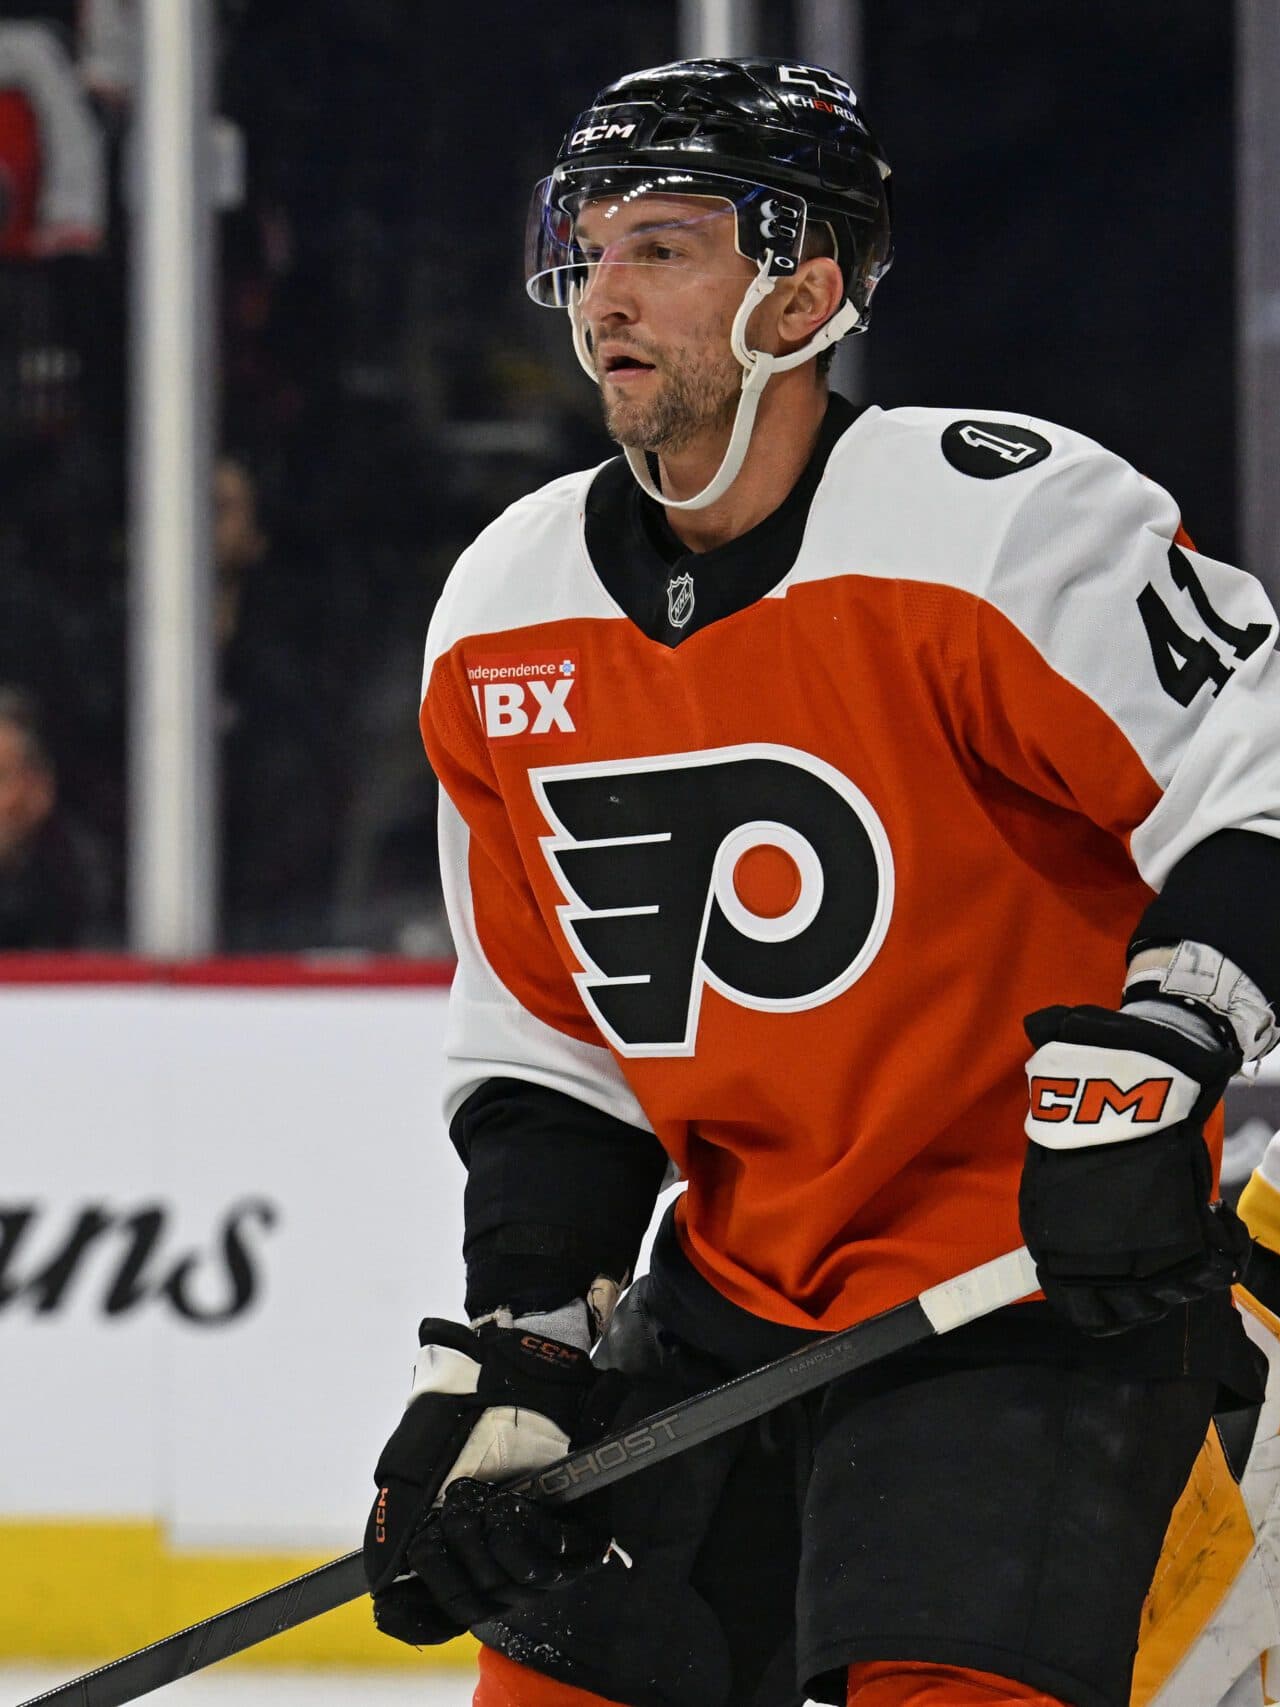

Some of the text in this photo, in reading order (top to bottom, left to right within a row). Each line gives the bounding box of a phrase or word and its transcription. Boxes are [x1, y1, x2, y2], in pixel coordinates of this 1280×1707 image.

[571, 124, 636, 146] CCM
[787, 94, 870, 136] CHEVROL
[959, 425, 1037, 464] 1
[1136, 542, 1272, 708] 41
[471, 679, 576, 738] BX
[1031, 1075, 1174, 1124] CM
[539, 1414, 681, 1495] GHOST
[375, 1487, 389, 1543] CCM
